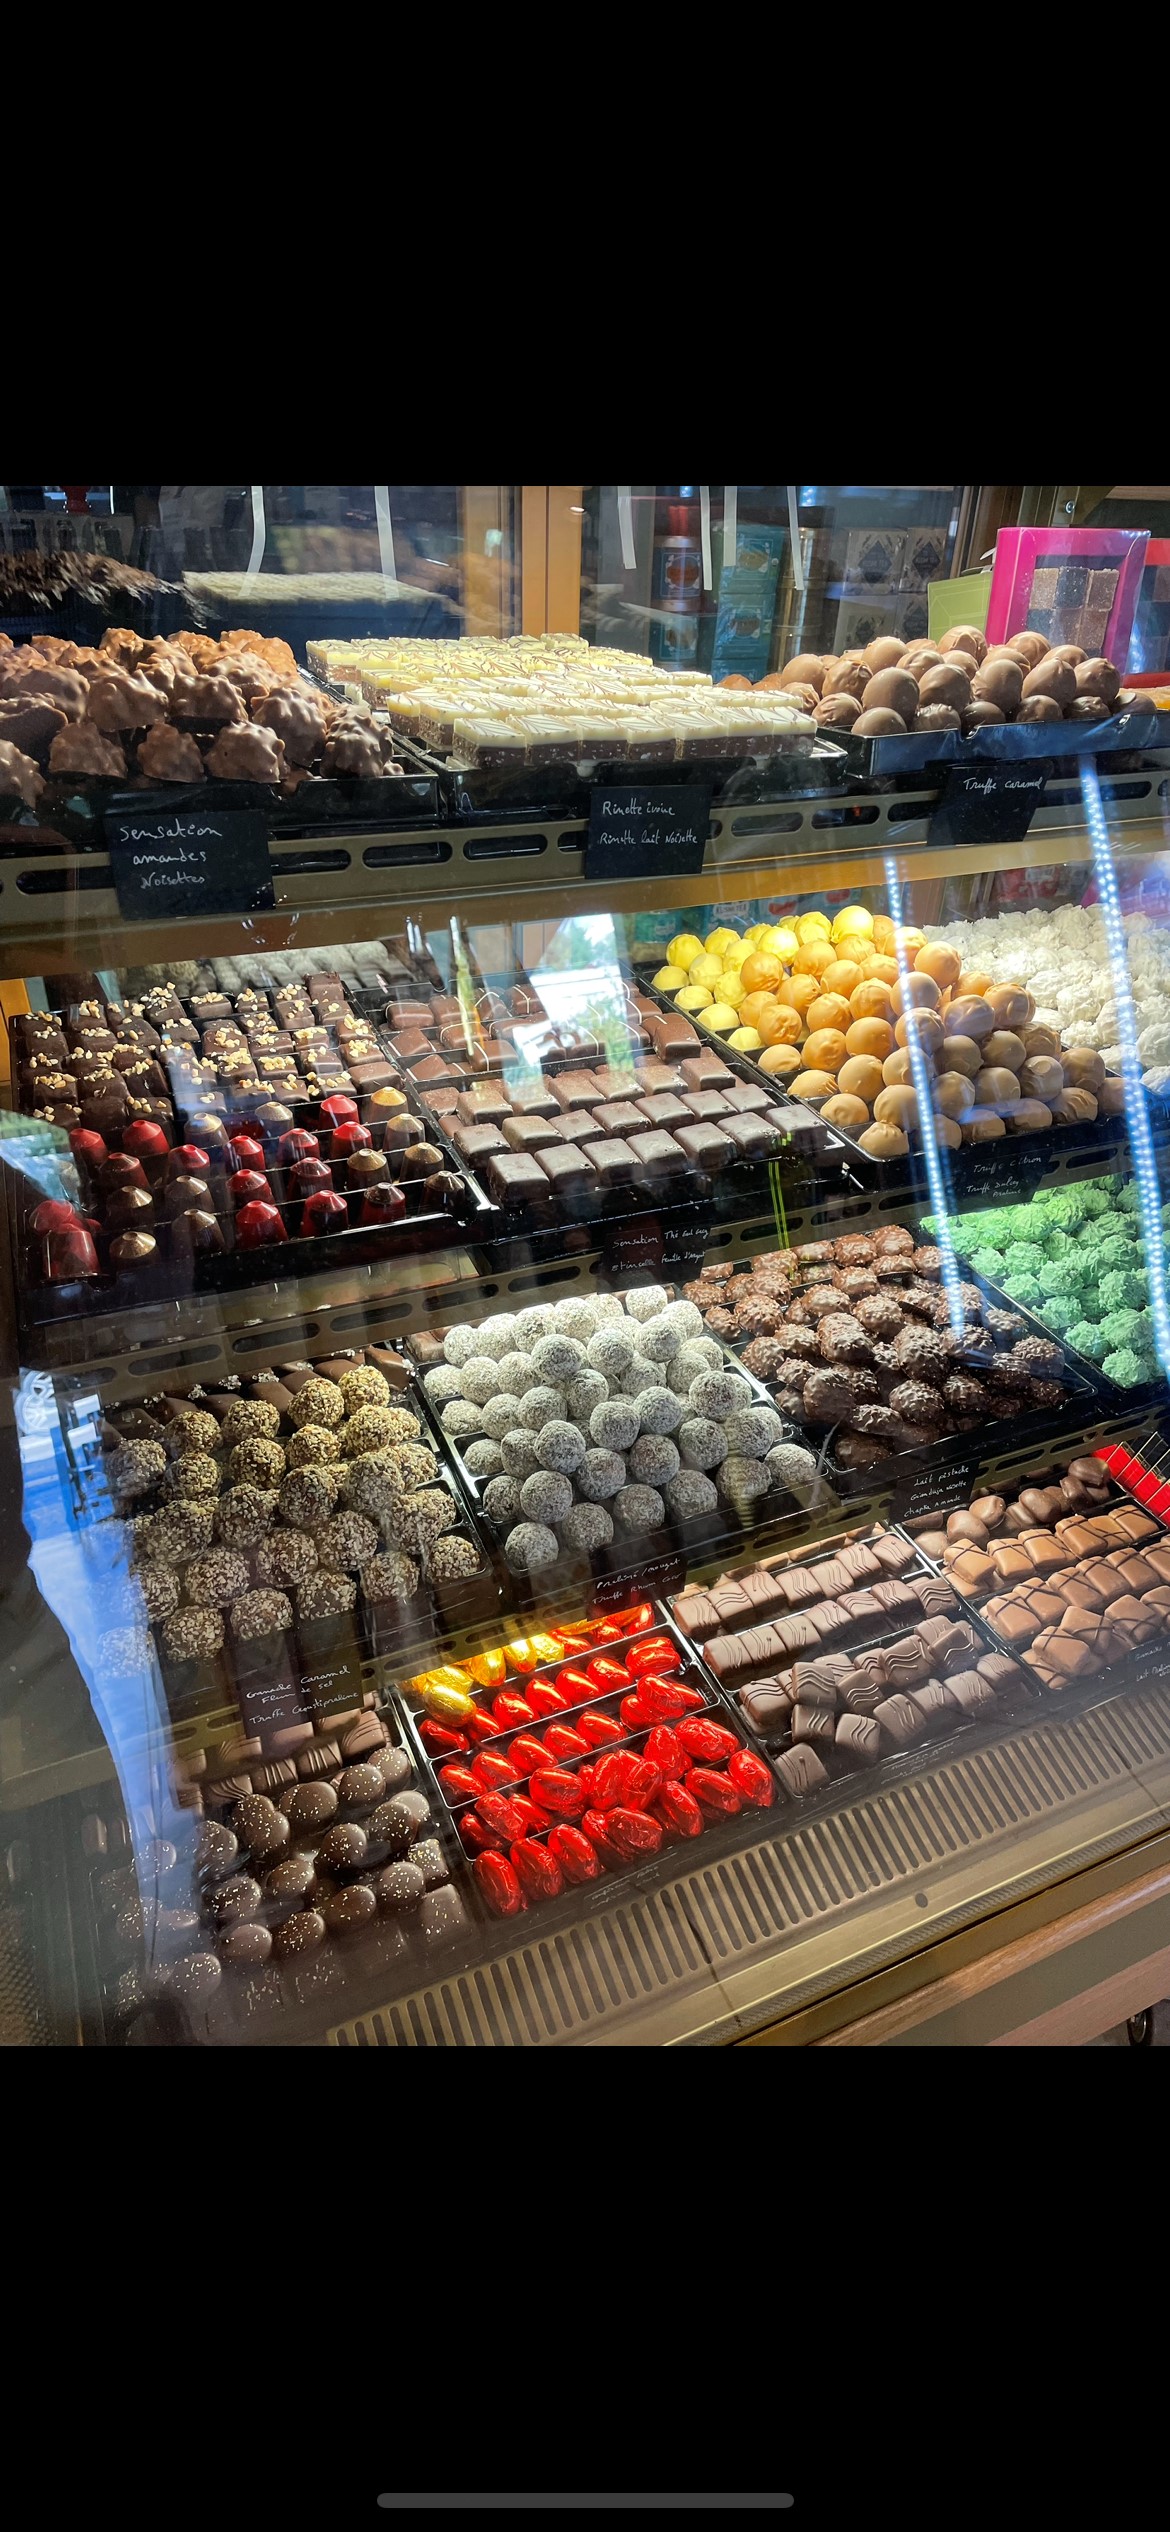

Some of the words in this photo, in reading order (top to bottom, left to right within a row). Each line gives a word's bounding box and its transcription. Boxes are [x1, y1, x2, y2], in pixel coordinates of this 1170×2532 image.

[963, 777, 997, 795] Truffe
[646, 802, 676, 816] ivoire
[641, 828, 660, 845] lait
[664, 828, 698, 844] Noisette
[132, 848, 207, 866] amandes
[140, 871, 206, 890] Noisettes
[664, 1229, 679, 1240] Thé
[592, 1591, 623, 1605] Truffe
[246, 1683, 292, 1699] Ganache
[249, 1708, 285, 1724] Truffe
